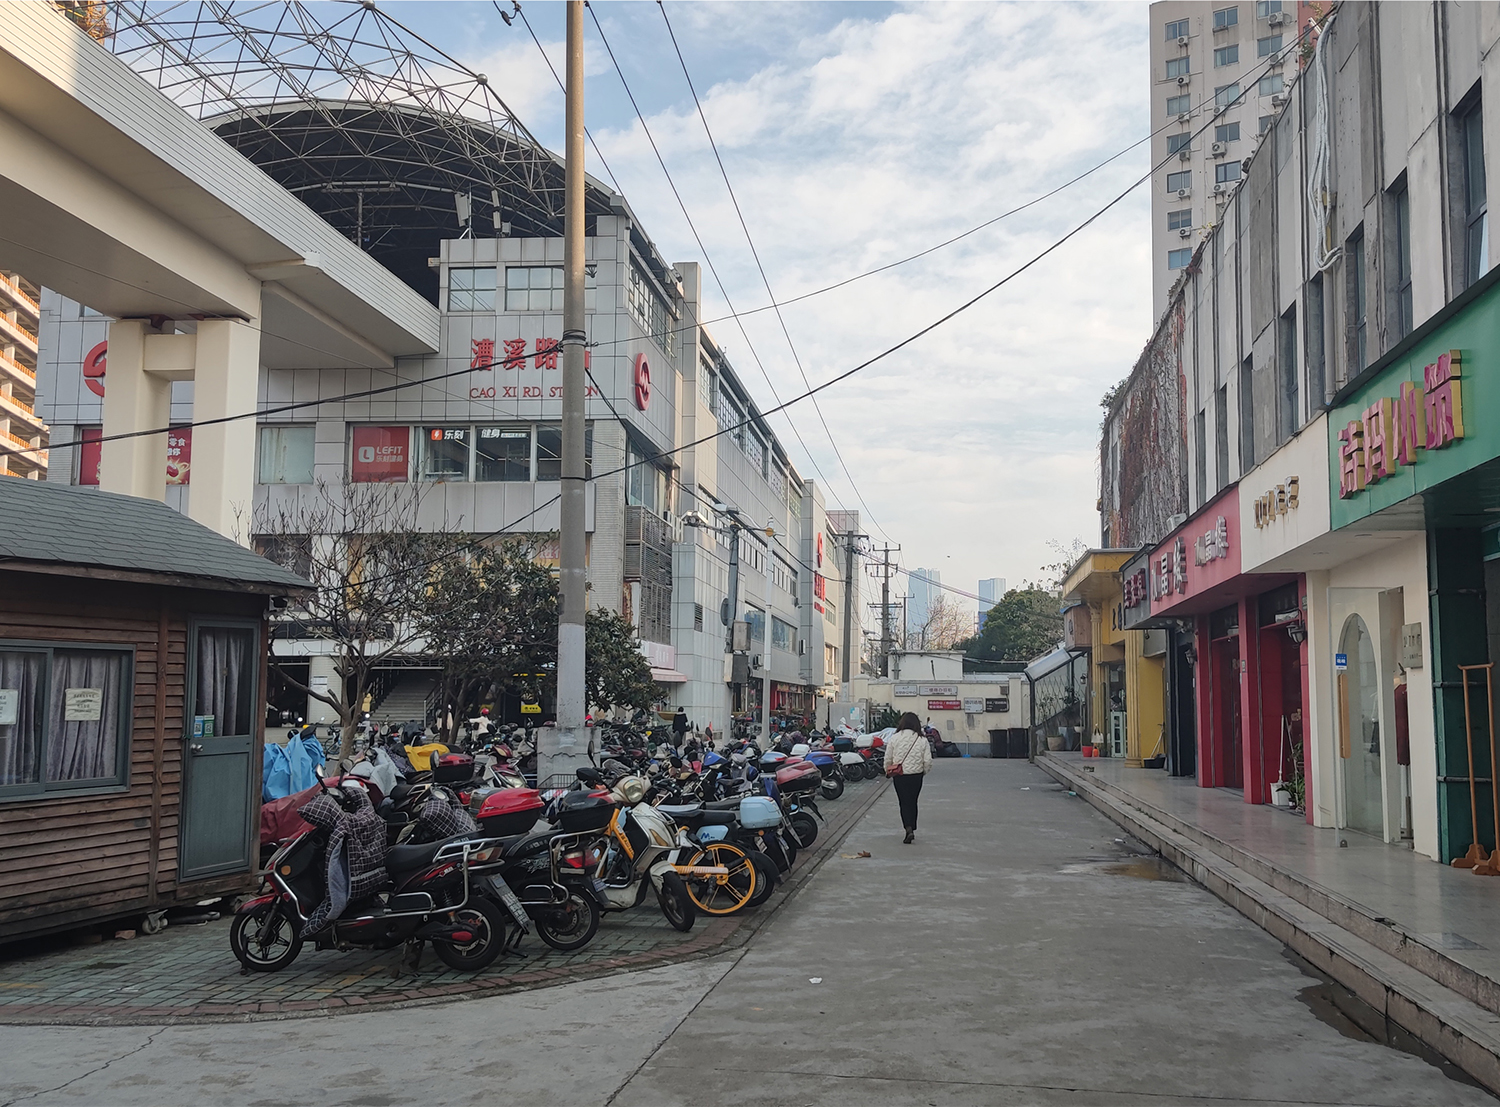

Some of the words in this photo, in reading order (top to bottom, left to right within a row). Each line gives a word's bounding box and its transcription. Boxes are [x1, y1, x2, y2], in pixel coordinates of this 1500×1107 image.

[470, 338, 590, 371] 漕溪路
[470, 387, 496, 398] CAO
[502, 386, 517, 398] XI
[523, 386, 543, 398] RD.
[549, 386, 599, 398] STON
[444, 430, 464, 440] 乐刻
[481, 429, 501, 438] 健身
[376, 446, 403, 454] LEFIT
